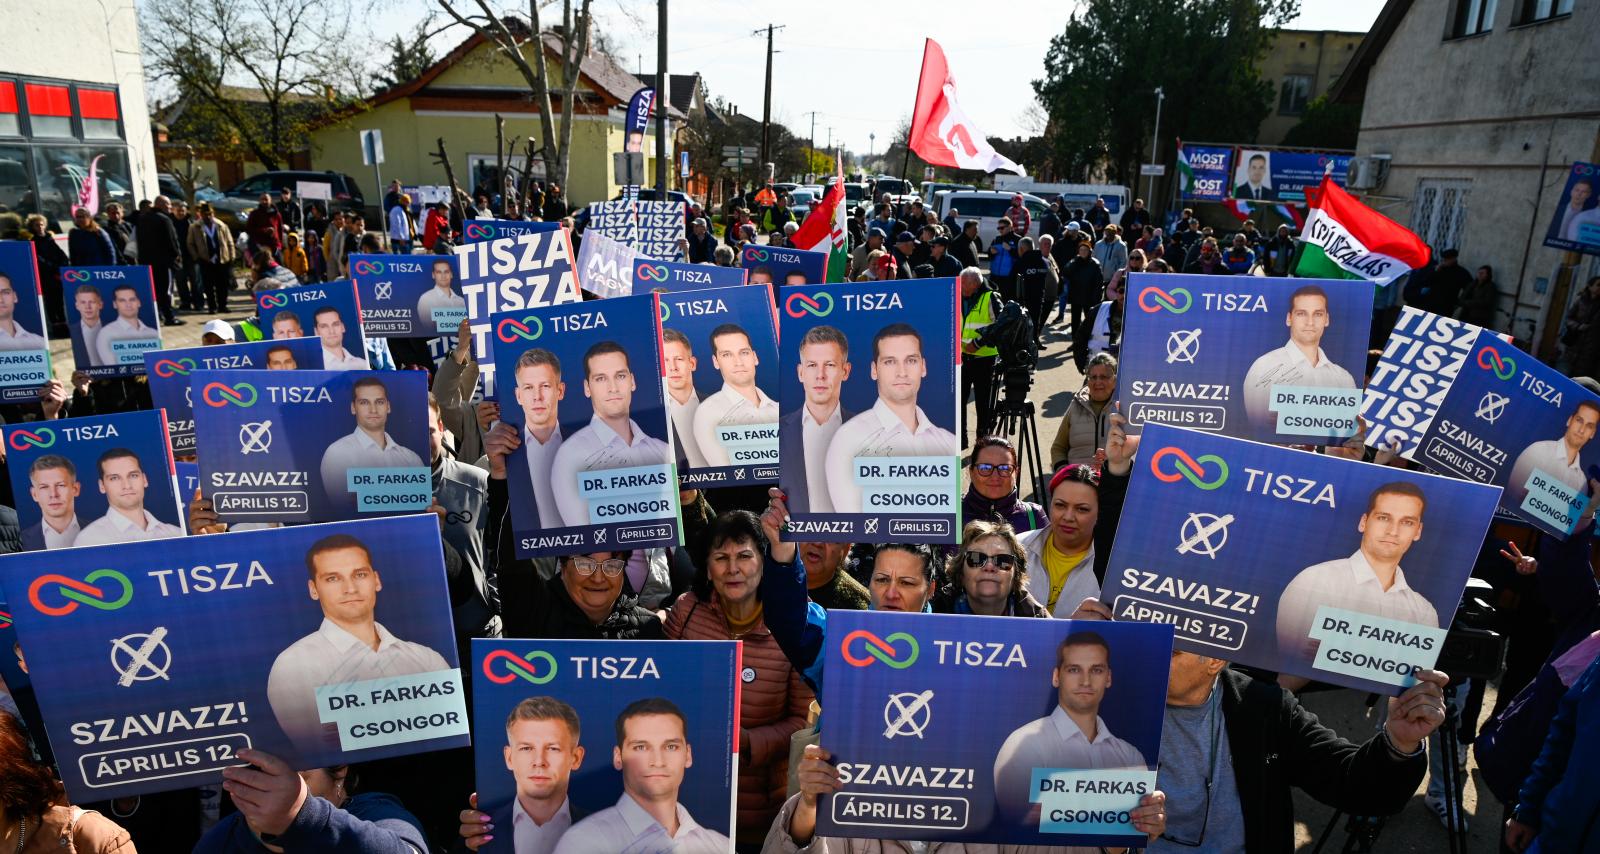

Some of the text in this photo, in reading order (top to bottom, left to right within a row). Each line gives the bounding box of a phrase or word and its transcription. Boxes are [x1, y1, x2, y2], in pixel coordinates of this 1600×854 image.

[636, 89, 653, 128] TISZA
[1190, 153, 1226, 164] MOST
[589, 200, 635, 215] TISZA
[637, 200, 685, 214] TISZA
[590, 213, 637, 228] TISZA
[638, 214, 685, 228] TISZA
[595, 227, 638, 241] ISZA
[638, 228, 685, 241] TISZA
[453, 229, 571, 280] TISZA
[772, 252, 801, 264] TISZA
[93, 271, 126, 280] TISZA
[388, 263, 423, 273] TISZA
[588, 253, 634, 288] MO
[674, 270, 712, 284] TISZA
[291, 289, 327, 303] TISZA
[462, 271, 583, 319] TISZA
[842, 292, 903, 312] TISZA
[1201, 293, 1268, 313] TISZA
[360, 309, 412, 318] SZAVAZZ!
[676, 299, 728, 317] TISZA
[365, 321, 408, 331] ÁPRILIS 12.
[550, 311, 608, 333] TISZA
[1395, 305, 1482, 351] TISZ
[202, 354, 253, 370] TISZA
[1382, 333, 1467, 379] TISZ
[0, 371, 45, 382] ONGOR
[85, 368, 115, 376] ZAVAZZ!
[1131, 380, 1230, 401] SZAVAZZ!
[1370, 361, 1453, 407] TISZ
[1519, 371, 1563, 408] TISZA
[266, 386, 333, 404] TISZA
[1276, 393, 1356, 407] DR. FARKAS
[1135, 405, 1218, 424] ÁPRILIS 12.
[1361, 388, 1437, 434] TISZ
[1283, 416, 1353, 430] CSONGOR
[62, 424, 119, 442] TISZA
[721, 429, 779, 441] DR. FARK
[1438, 420, 1508, 466] SZAVAZZ!
[735, 449, 779, 461] CSONG
[1431, 442, 1473, 475] ÁPRILIS
[1475, 467, 1487, 482] 12.
[211, 471, 309, 487] SZAVAZZ!
[353, 474, 427, 485] DR. FARKAS
[757, 469, 779, 477] ÁPRIL
[859, 464, 950, 477] DR. FARKAS
[584, 473, 667, 491] DR. FARKAS
[1243, 468, 1337, 509] TISZA
[220, 495, 301, 509] ÁPRILIS 12.
[363, 494, 428, 505] CSONGOR
[870, 493, 950, 506] CSONGOR
[1532, 476, 1583, 510] DR. FARKAS
[596, 499, 670, 517] CSONGOR
[1528, 497, 1573, 527] CSONGOR
[787, 520, 945, 533] SZAVAZZ! ÁPRILIS 12.
[521, 527, 669, 550] SZAVAZZ! ÁPRILIS 12.
[147, 560, 274, 597] TISZA
[1121, 568, 1260, 615] SZAVAZZ!
[1124, 601, 1233, 642] ÁPRILIS 12.
[1321, 616, 1435, 651] DR. FARKAS
[933, 640, 1027, 668] TISZA
[570, 656, 660, 679] TISZA
[328, 681, 455, 711] DR. FARKAS
[70, 701, 249, 746] SZAVAZZ!
[349, 711, 460, 739] CSONGOR
[96, 748, 201, 778] ÁPRILIS
[836, 762, 975, 790] SZAVAZZ!
[1039, 778, 1147, 795] DR. FARKAS
[841, 802, 958, 821] ÁPRILIS 12.
[1049, 809, 1132, 824] CSONGO
